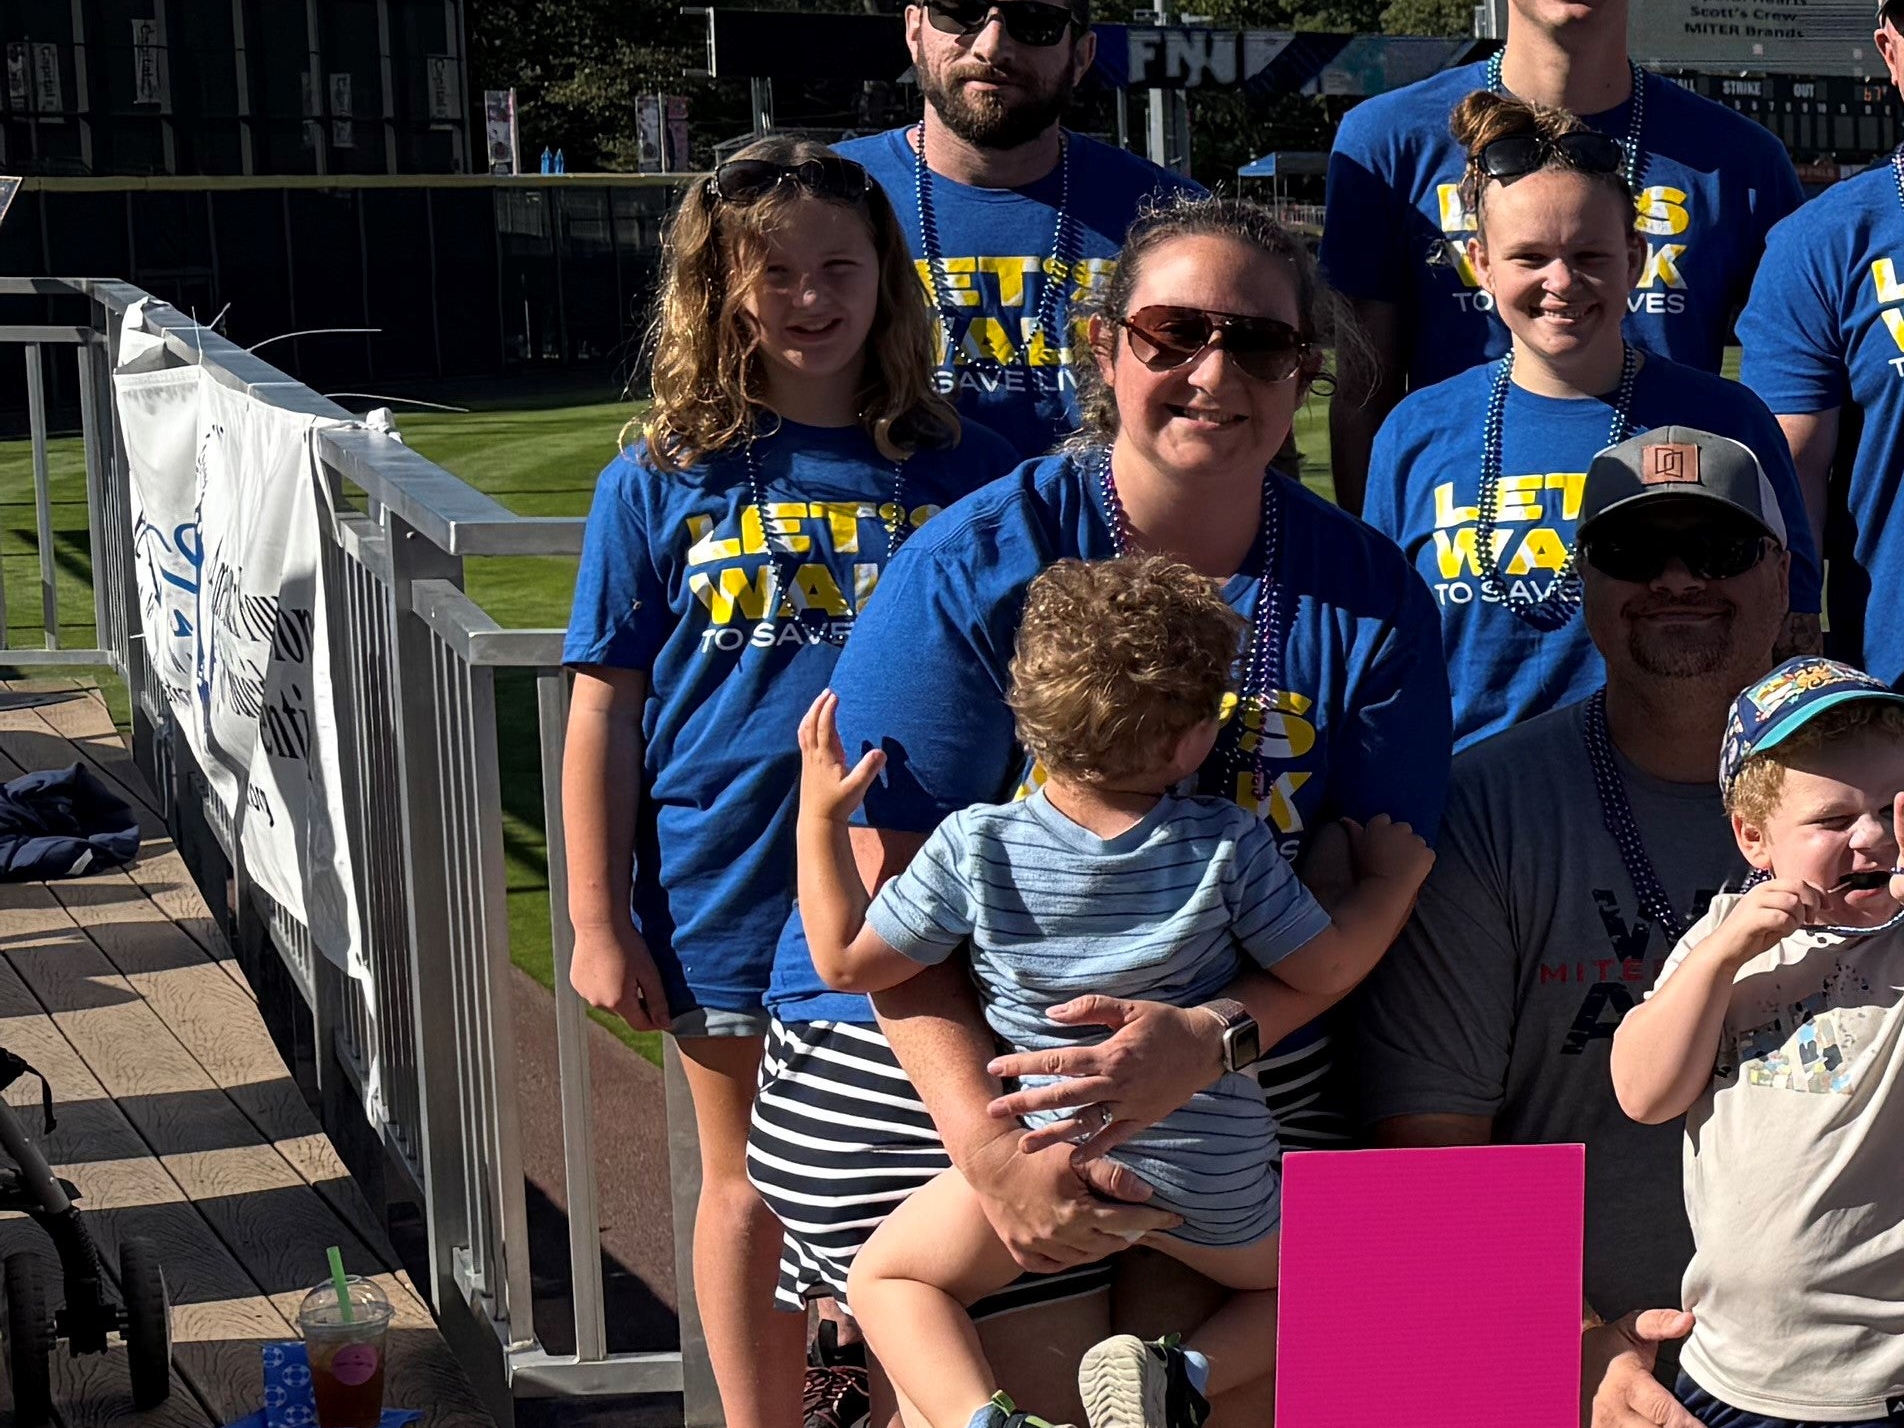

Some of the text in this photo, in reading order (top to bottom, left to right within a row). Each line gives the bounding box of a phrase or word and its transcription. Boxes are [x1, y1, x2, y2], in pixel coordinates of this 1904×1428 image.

[1691, 7, 1797, 21] Scott's Crew
[1685, 23, 1739, 36] MITER
[1723, 81, 1761, 96] STRIKE
[1452, 290, 1685, 314] TO VES
[1435, 473, 1588, 528] LET
[1435, 528, 1575, 579] WA
[689, 564, 878, 624] WAL
[1435, 580, 1562, 606] TO SAV
[702, 627, 744, 653] TO
